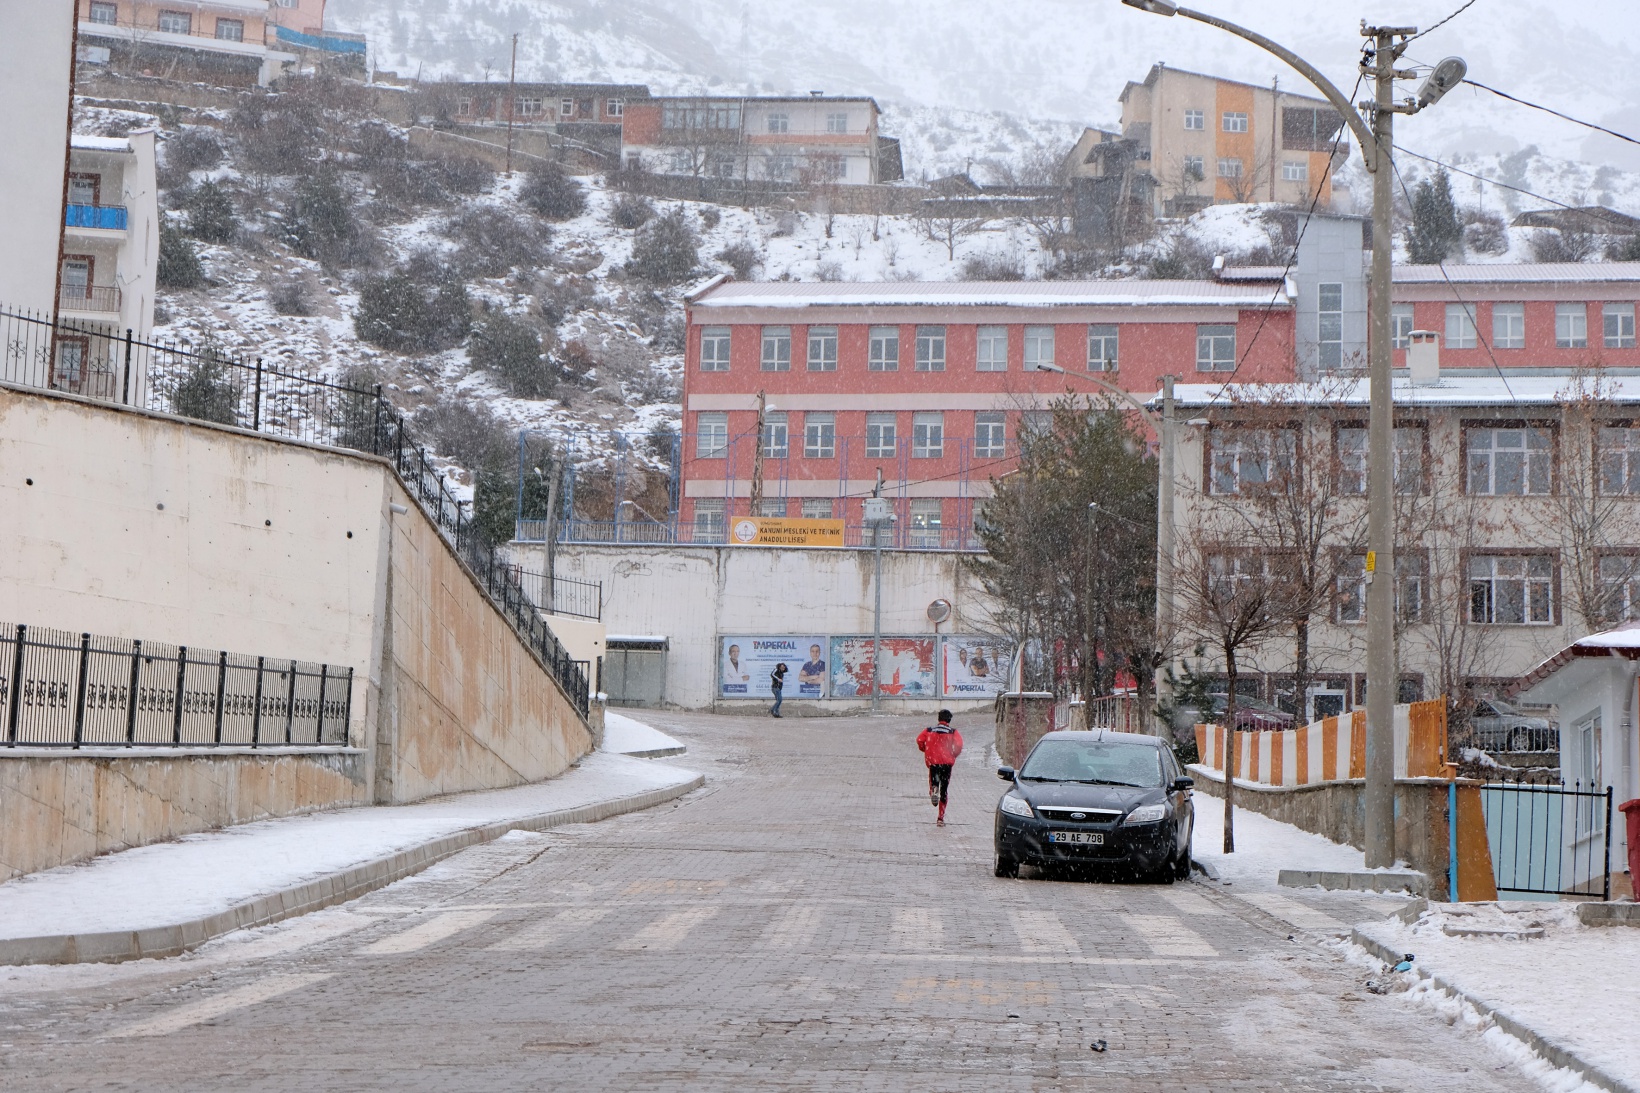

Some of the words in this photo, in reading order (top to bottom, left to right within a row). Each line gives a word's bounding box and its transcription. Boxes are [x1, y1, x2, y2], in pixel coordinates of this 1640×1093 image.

[783, 527, 808, 535] MESLEKİ
[788, 535, 806, 544] LİSESİ
[1056, 832, 1066, 842] 29
[1071, 834, 1082, 842] AE
